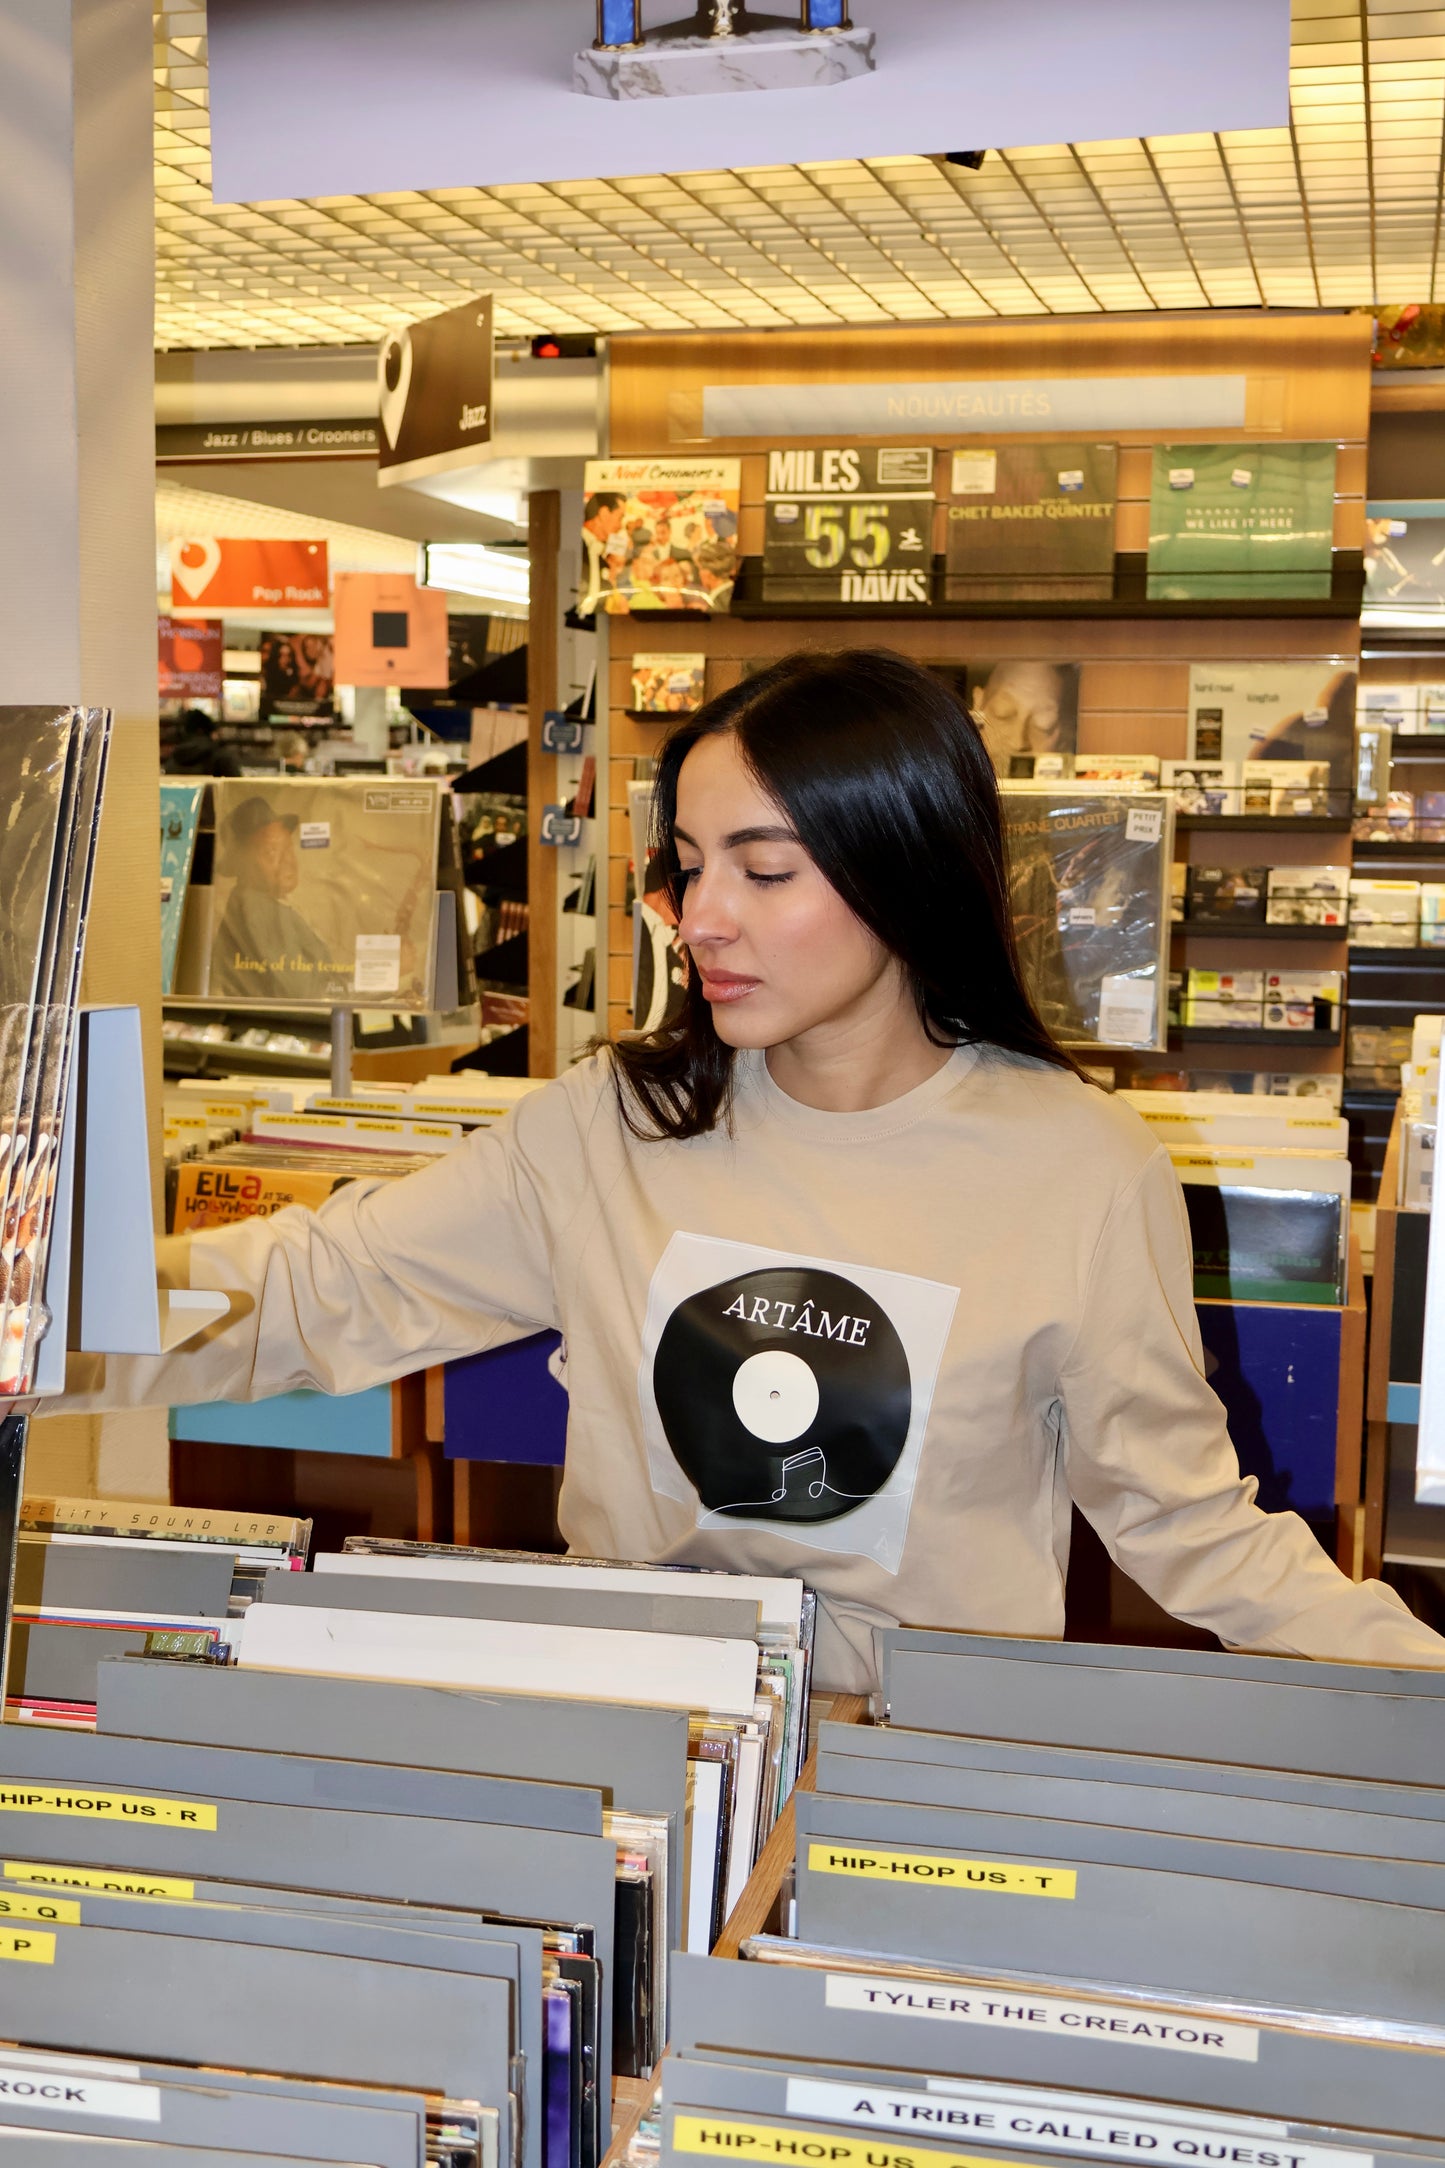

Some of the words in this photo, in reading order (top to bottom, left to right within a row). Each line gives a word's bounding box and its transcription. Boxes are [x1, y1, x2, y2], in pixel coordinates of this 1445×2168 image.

[887, 389, 1051, 418] NOUVEAUTÉS
[459, 404, 487, 431] Jazz
[203, 432, 238, 447] Jazz
[251, 430, 294, 446] Blues
[307, 428, 376, 444] Crooners
[768, 449, 861, 492] MILES
[949, 506, 989, 520] CHET
[992, 504, 1044, 519] BAKER
[1046, 503, 1114, 519] QUINTET
[1185, 518, 1205, 529] WE
[1210, 518, 1237, 529] LIKE
[1242, 518, 1254, 528] IT
[1260, 517, 1293, 528] HERE
[804, 505, 891, 569] 55
[252, 586, 282, 602] Pop
[285, 586, 323, 600] Rock
[840, 568, 927, 602] DAVIS
[1054, 810, 1120, 831] QUARTET
[1133, 812, 1157, 822] PETIT
[1133, 824, 1153, 834] PRIX
[233, 952, 267, 974] king
[270, 954, 285, 971] of
[290, 953, 314, 972] the
[185, 1197, 268, 1216] HOLLYWOOD
[262, 1192, 274, 1200] AT
[276, 1192, 294, 1203] THE
[722, 1293, 871, 1346] ARTÂME
[131, 1513, 212, 1530] SOUND
[234, 1522, 276, 1535] LAB
[1, 1793, 112, 1811] HIP-HOP
[122, 1803, 156, 1816] US
[180, 1810, 198, 1822] R
[830, 1855, 955, 1878] HIP-HOP
[967, 1869, 1008, 1884] US
[1035, 1876, 1052, 1888] T
[37, 1906, 58, 1919] Q
[14, 1939, 31, 1951] P
[863, 1989, 971, 2013] TYLER
[981, 2002, 1048, 2023] THE
[1059, 2013, 1225, 2048] CREATOR
[853, 2100, 876, 2114] A
[887, 2103, 996, 2129] TRIBE
[1010, 2117, 1158, 2150] CALLED
[1172, 2140, 1305, 2168] QUEST
[700, 2130, 851, 2160] HIP-HOP
[866, 2152, 915, 2168] US
